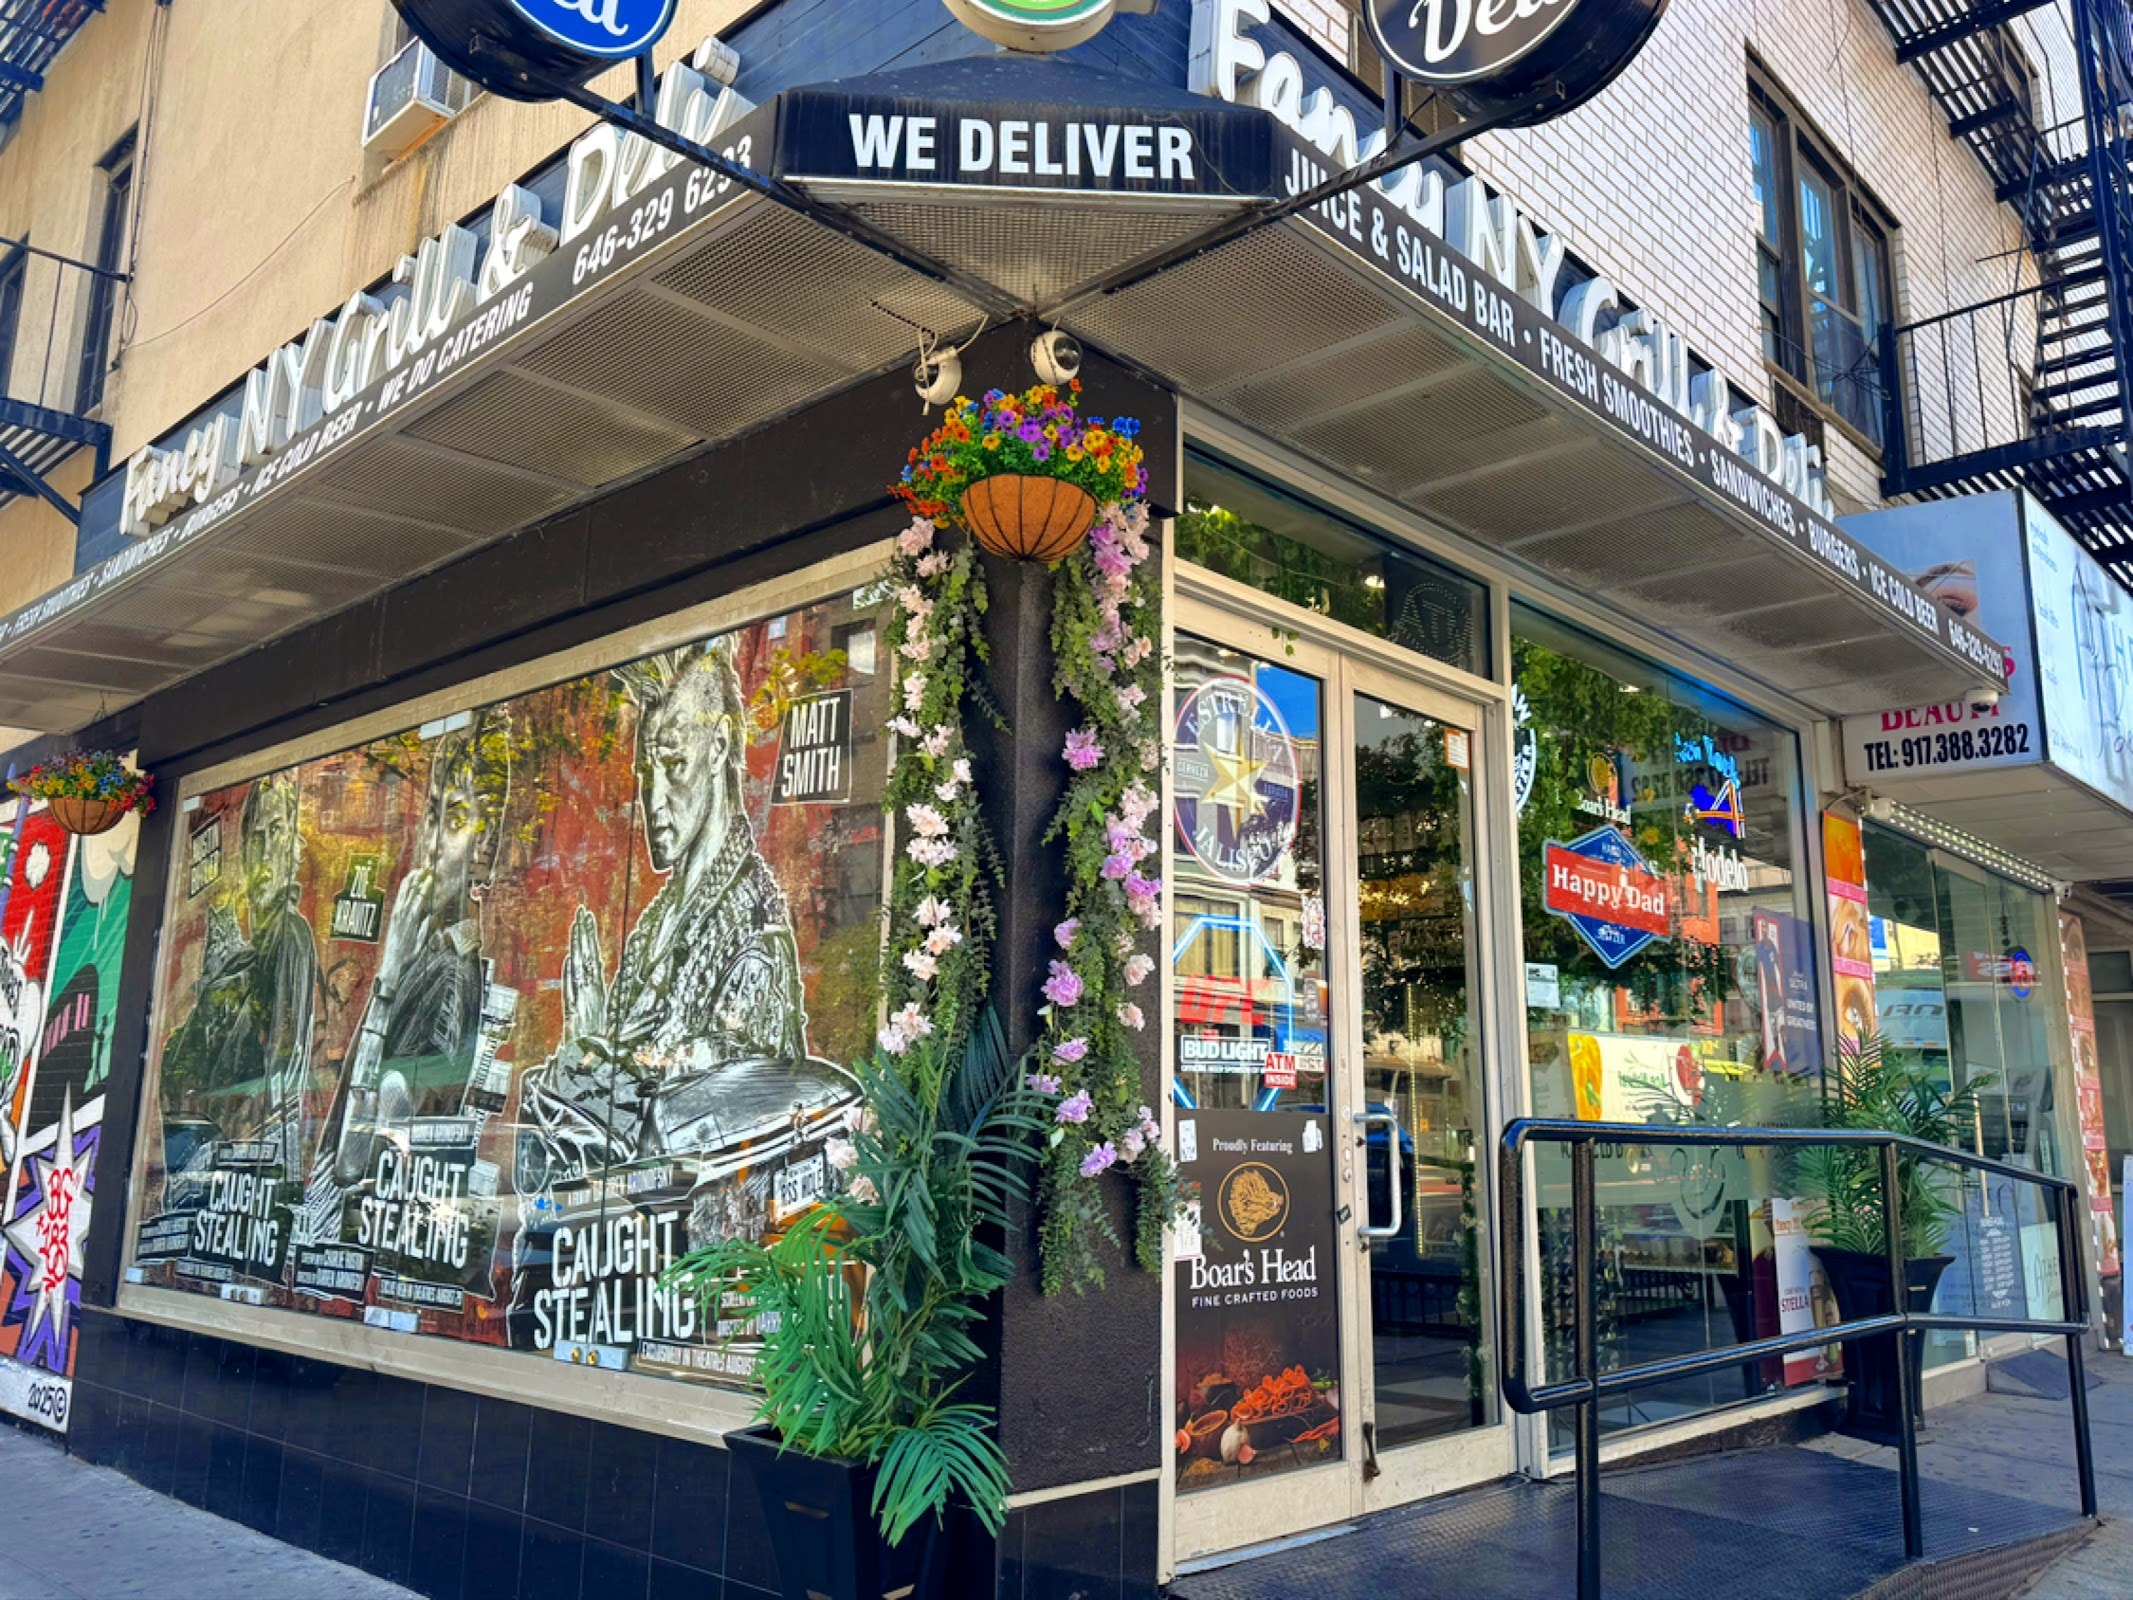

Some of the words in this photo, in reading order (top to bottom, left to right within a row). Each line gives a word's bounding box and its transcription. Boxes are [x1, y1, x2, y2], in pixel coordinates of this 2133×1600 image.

[1408, 0, 1558, 64] De
[849, 113, 936, 170] WE
[959, 117, 1195, 180] DELIVER
[251, 456, 282, 497] ICE
[277, 430, 321, 477] COLD
[316, 401, 363, 446] BEER
[378, 366, 410, 413] WE
[408, 351, 437, 393] DO
[437, 281, 534, 374] CATERING
[573, 187, 674, 286] 646-329
[1463, 175, 1564, 320] NY
[1713, 367, 1745, 456] &
[120, 411, 226, 536] Fancy
[237, 317, 325, 464] NY
[322, 224, 461, 413] Grill
[477, 183, 531, 305] &
[1371, 207, 1388, 261] &
[1397, 223, 1467, 313] SALAD
[1474, 280, 1516, 347] BAR
[1539, 327, 1600, 405] FRESH
[1603, 372, 1695, 469] SMOOTHIES
[1709, 448, 1797, 537] SANDWICHES
[1807, 516, 1861, 581] BURGERS
[1868, 560, 1889, 600] ICE
[1888, 574, 1915, 620] COLD
[1914, 594, 1940, 636] BEER
[789, 697, 840, 750] MATT
[1864, 741, 1899, 772] TEL:
[1901, 723, 2030, 768] 917.388.3282
[781, 744, 841, 798] SMITH
[1552, 864, 1623, 911] Happy
[1627, 884, 1666, 917] Dad
[1184, 1040, 1220, 1059] BUD
[1221, 1042, 1268, 1060] LIGHT
[1266, 1053, 1295, 1071] ATM
[1266, 1075, 1295, 1087] INSIDE
[1213, 1138, 1248, 1155] Proudly
[1250, 1138, 1294, 1155] Featuring
[209, 1170, 277, 1220] CAUGHT
[375, 1150, 467, 1208] CAUGHT
[194, 1208, 279, 1268] STEALING
[358, 1196, 470, 1270] STEALING
[551, 1211, 680, 1287] CAUGHT
[1189, 1248, 1256, 1289] Boar's
[1261, 1244, 1317, 1284] Head
[533, 1271, 695, 1350] STEALING
[1192, 1294, 1220, 1308] FINE
[1224, 1290, 1278, 1305] CRAFTED
[1281, 1286, 1318, 1300] FOODS
